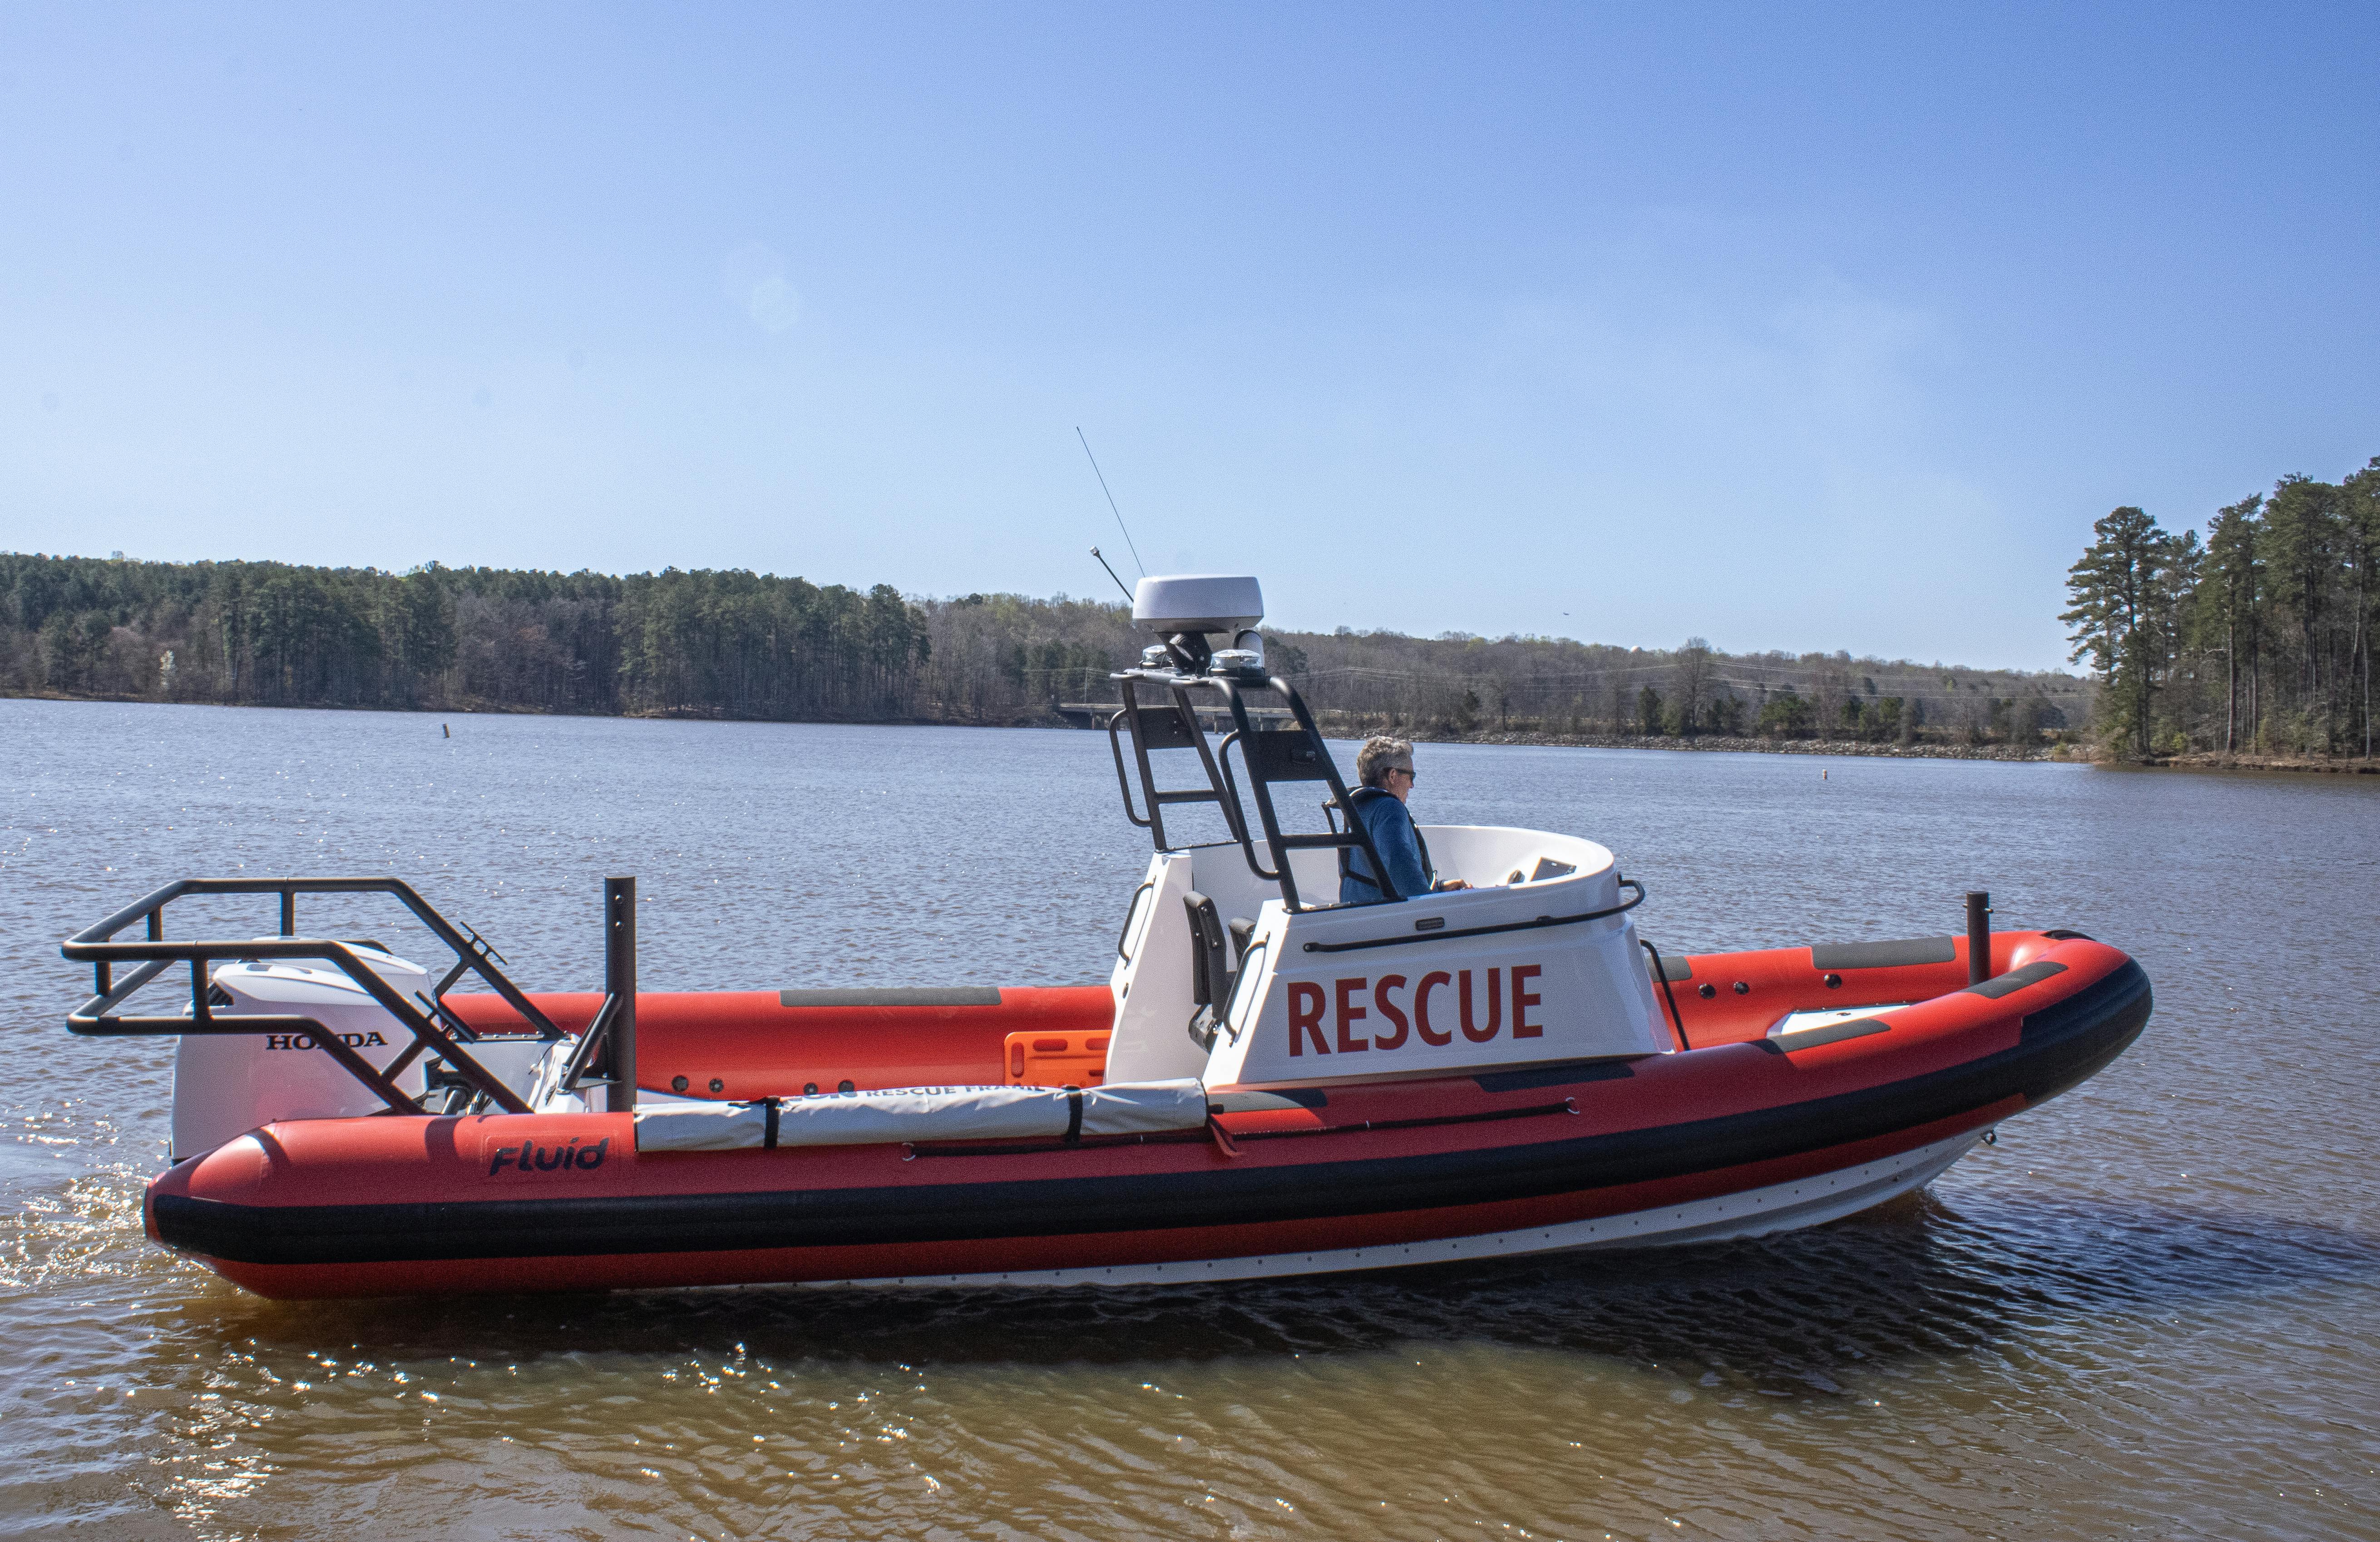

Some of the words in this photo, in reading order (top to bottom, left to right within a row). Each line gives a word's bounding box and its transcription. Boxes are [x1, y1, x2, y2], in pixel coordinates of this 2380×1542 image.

[1287, 964, 1543, 1057] RESCUE
[267, 1031, 388, 1050] HODA
[866, 1087, 956, 1097] RESCUE
[489, 1136, 609, 1176] Fluid
